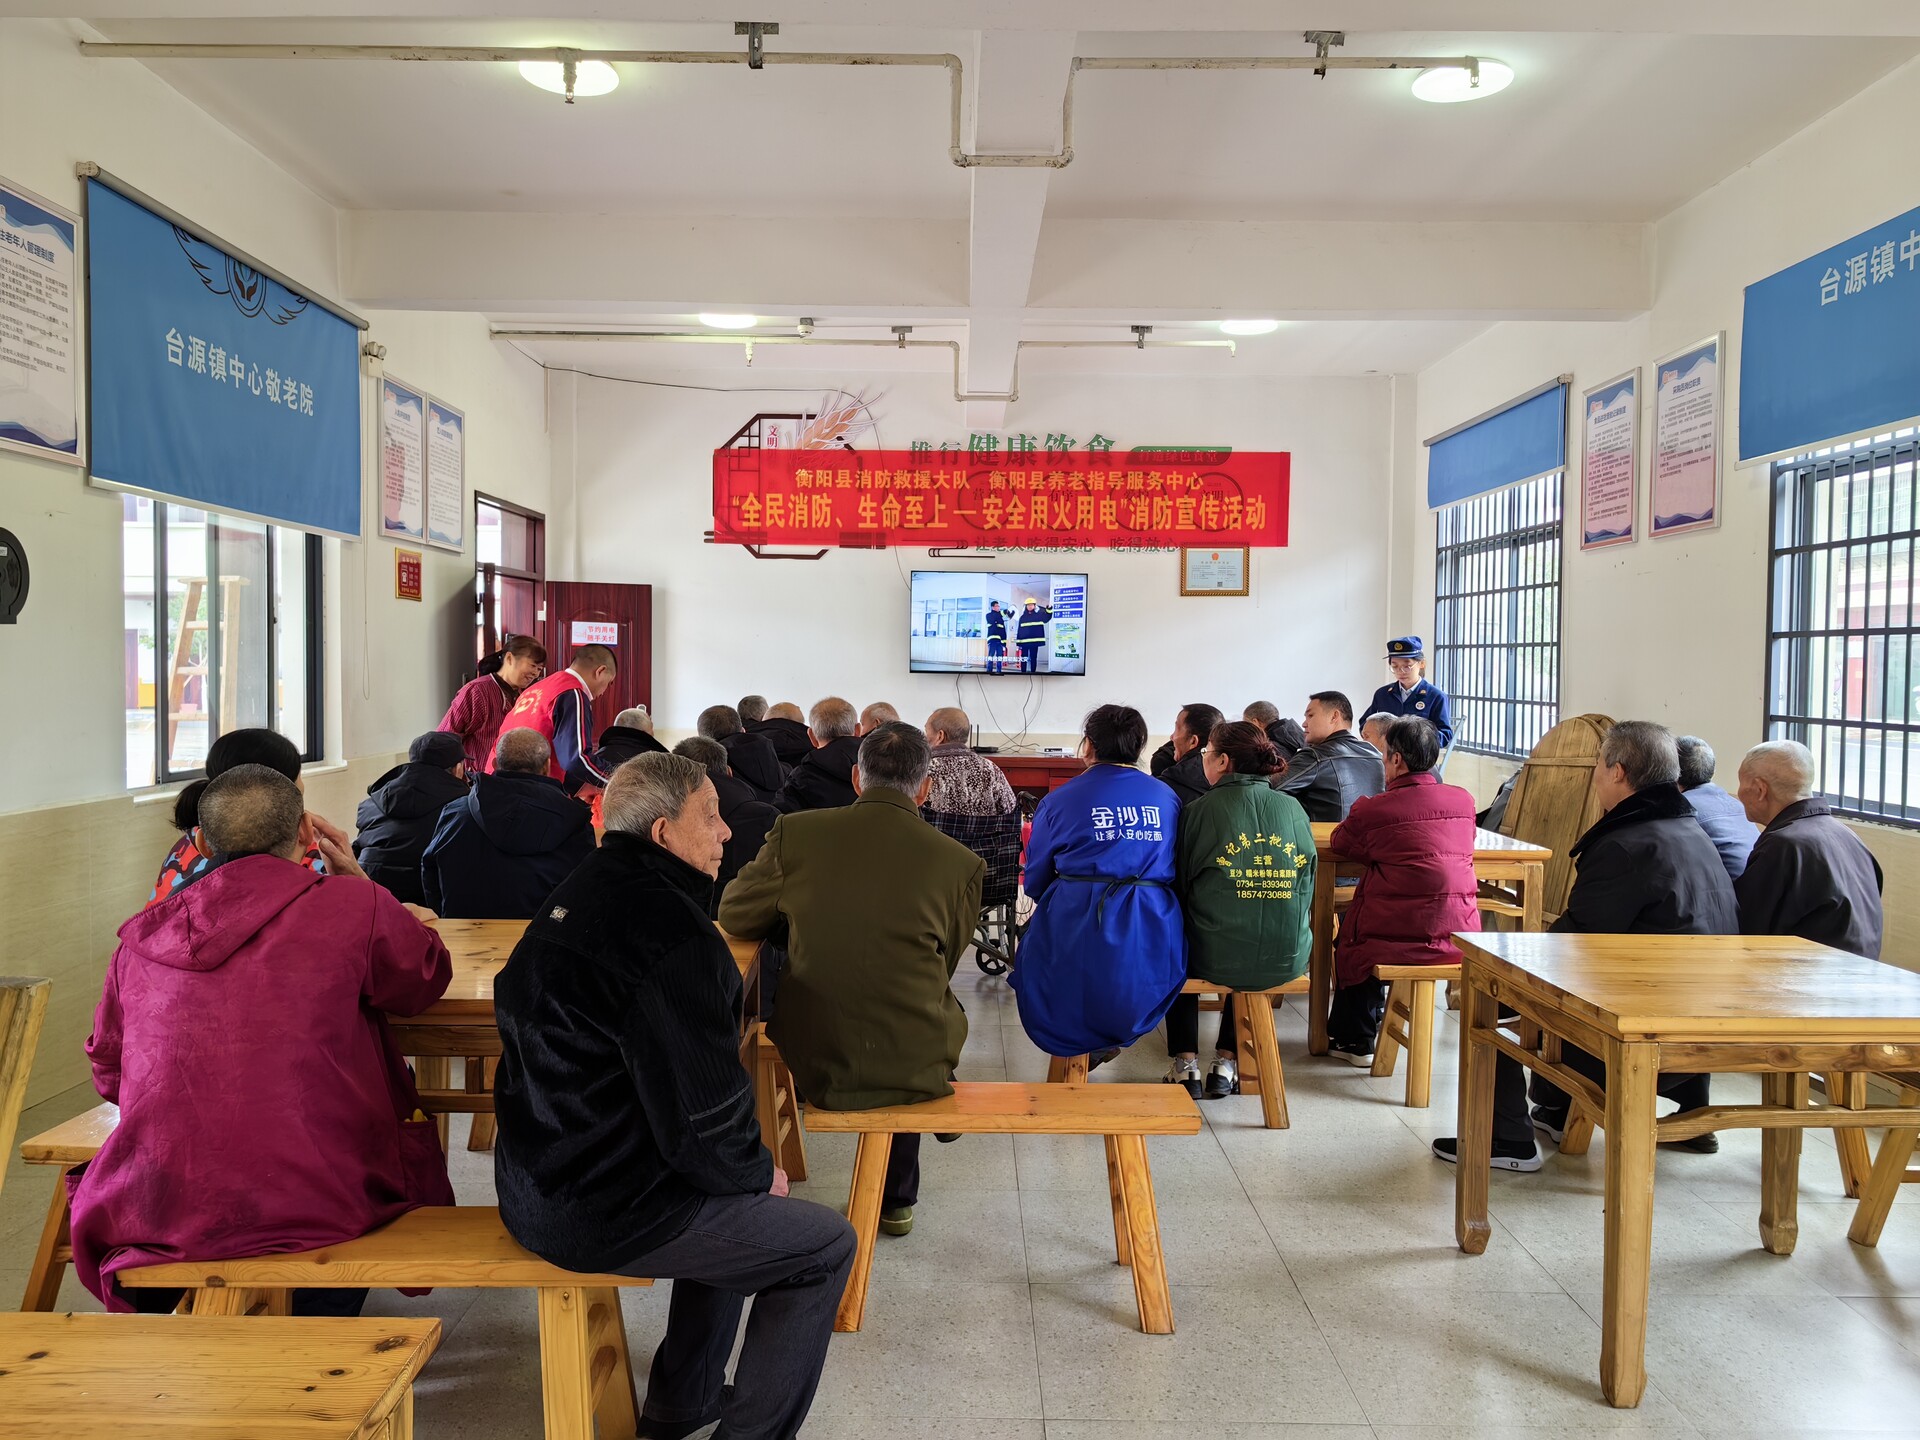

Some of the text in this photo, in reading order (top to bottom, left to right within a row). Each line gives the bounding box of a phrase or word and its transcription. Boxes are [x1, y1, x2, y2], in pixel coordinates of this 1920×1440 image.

[165, 327, 315, 418] 台源镇中心敬老院
[767, 425, 778, 448] 文明
[909, 432, 1117, 467] 推行健康饮食
[795, 468, 1204, 491] 衡阳县消防救援大队 衡阳县养老指导服务中心
[973, 535, 1182, 554] 让老人吃得安心 吃得放心
[1091, 805, 1161, 829] 金沙河
[1094, 829, 1163, 842] 让家人安心吃面
[1253, 855, 1273, 866] 主营
[1229, 869, 1243, 878] 豆沙
[1236, 890, 1292, 899] 18574730888
